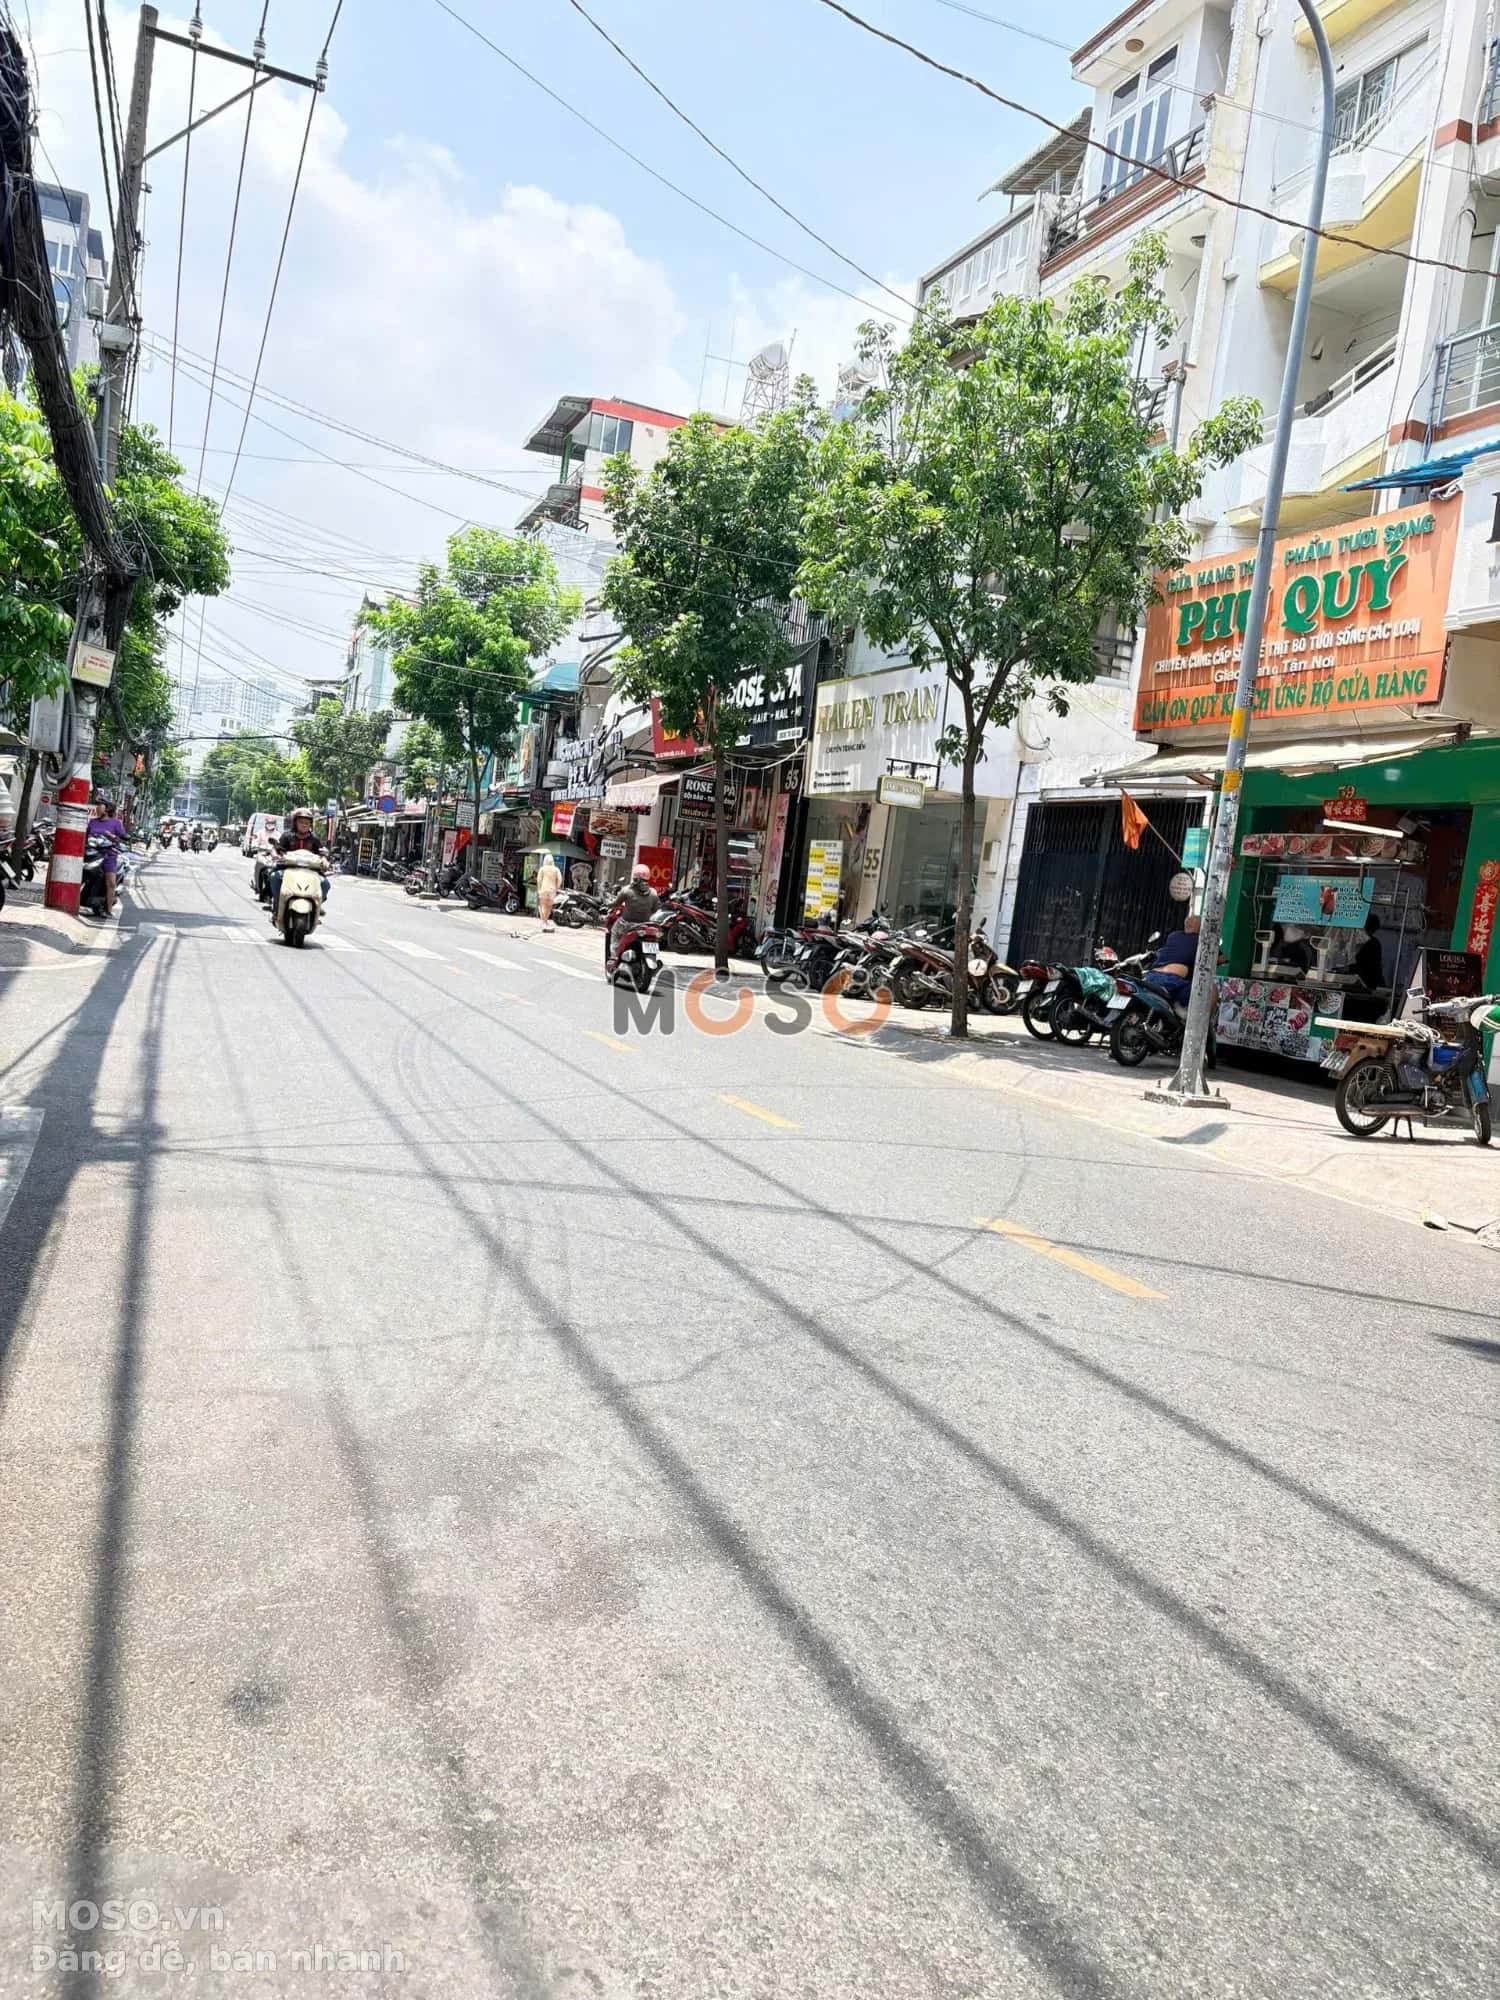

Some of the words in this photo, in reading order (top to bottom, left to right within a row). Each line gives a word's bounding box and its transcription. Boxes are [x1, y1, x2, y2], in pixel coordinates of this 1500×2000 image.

[1281, 539, 1409, 633] QUÝ
[721, 671, 766, 709] OSE
[1374, 664, 1428, 699] HÀNG
[685, 779, 714, 793] ROSE
[864, 848, 880, 870] 55
[650, 864, 672, 883] ỘC
